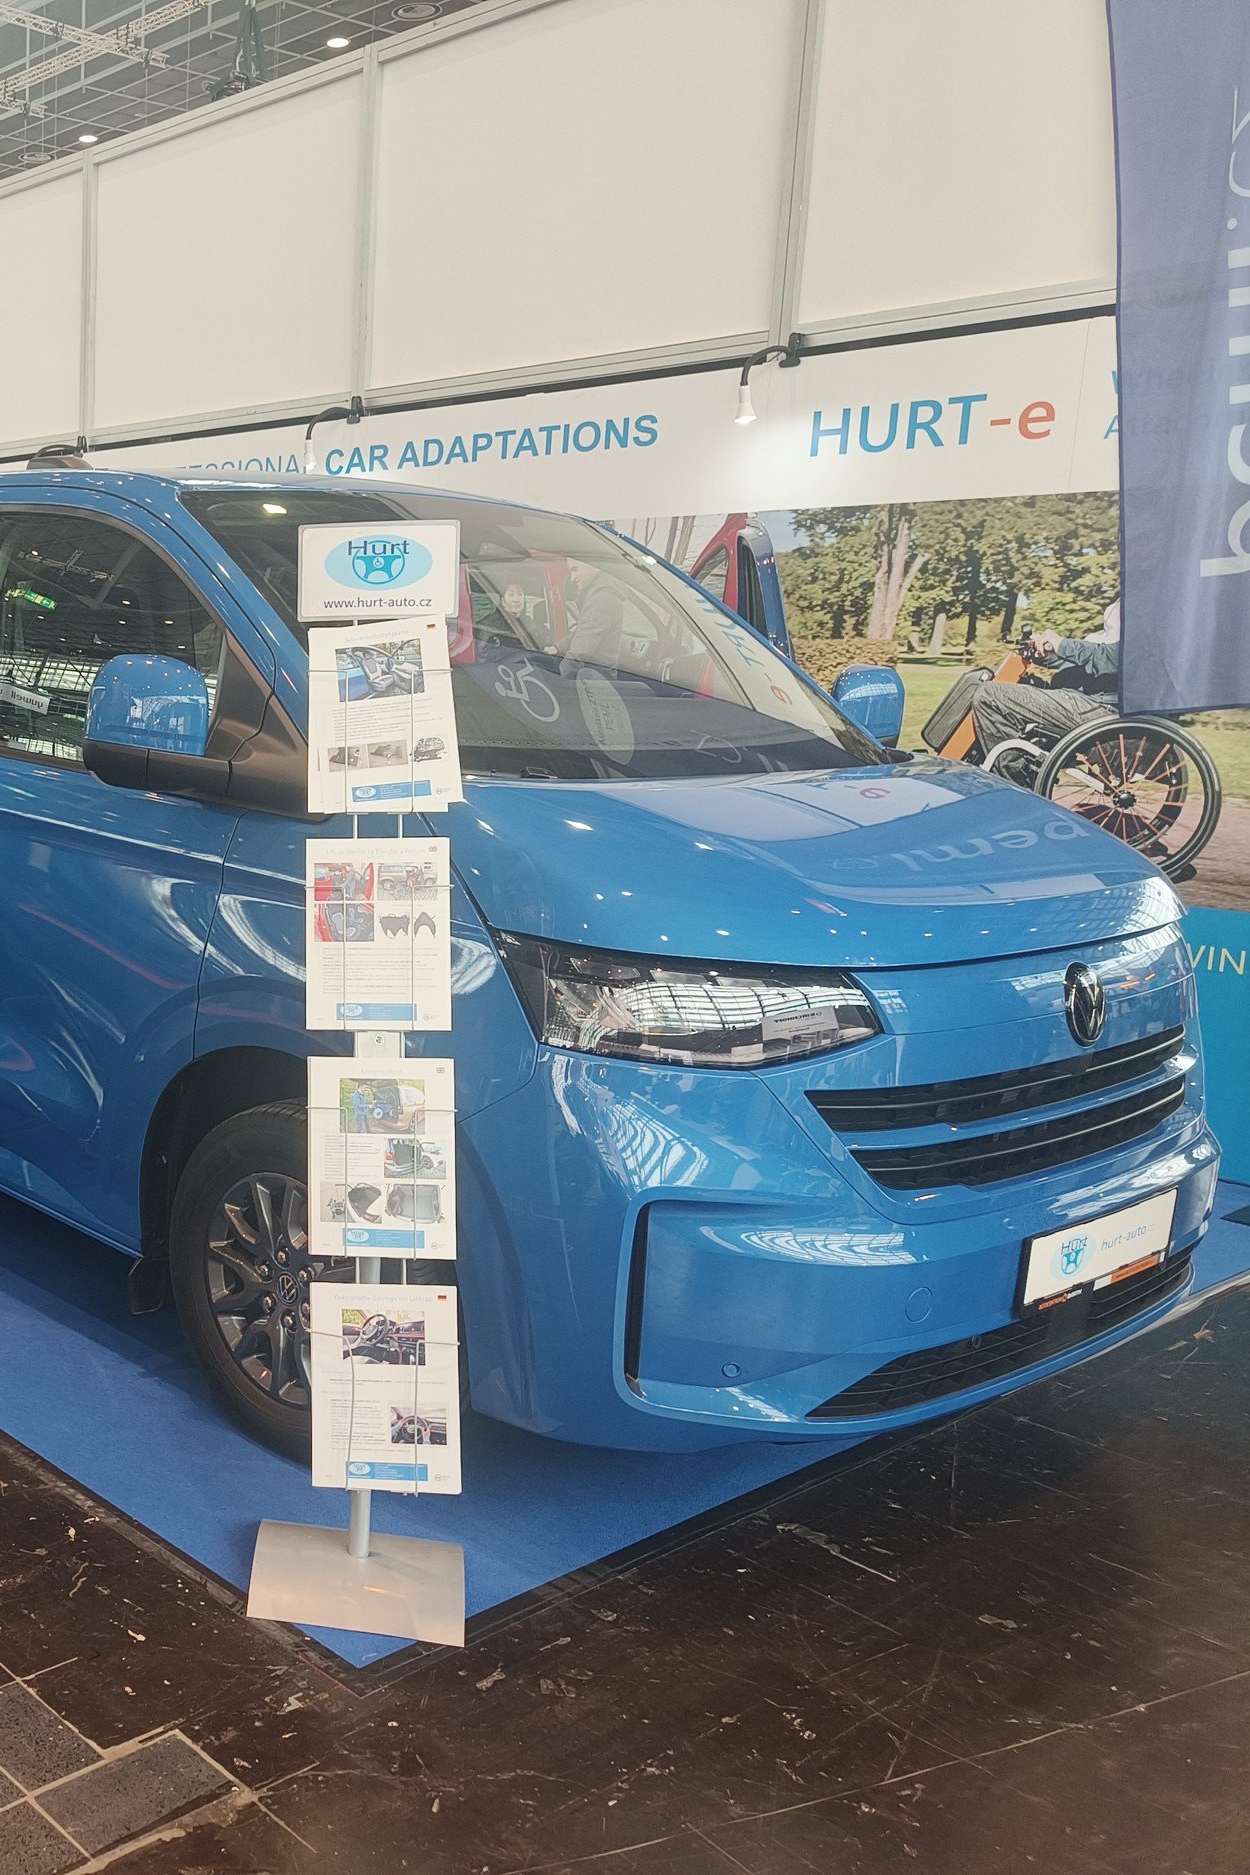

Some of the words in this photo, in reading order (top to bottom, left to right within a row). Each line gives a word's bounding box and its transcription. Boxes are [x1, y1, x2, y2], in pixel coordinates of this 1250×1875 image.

[809, 393, 1057, 458] HURT-e
[324, 443, 389, 477] CAR
[396, 414, 660, 471] ADAPTATIONS
[347, 540, 410, 556] Hurt
[323, 597, 432, 609] www.hurt-auto.cz
[1060, 1236, 1088, 1255] Hurt
